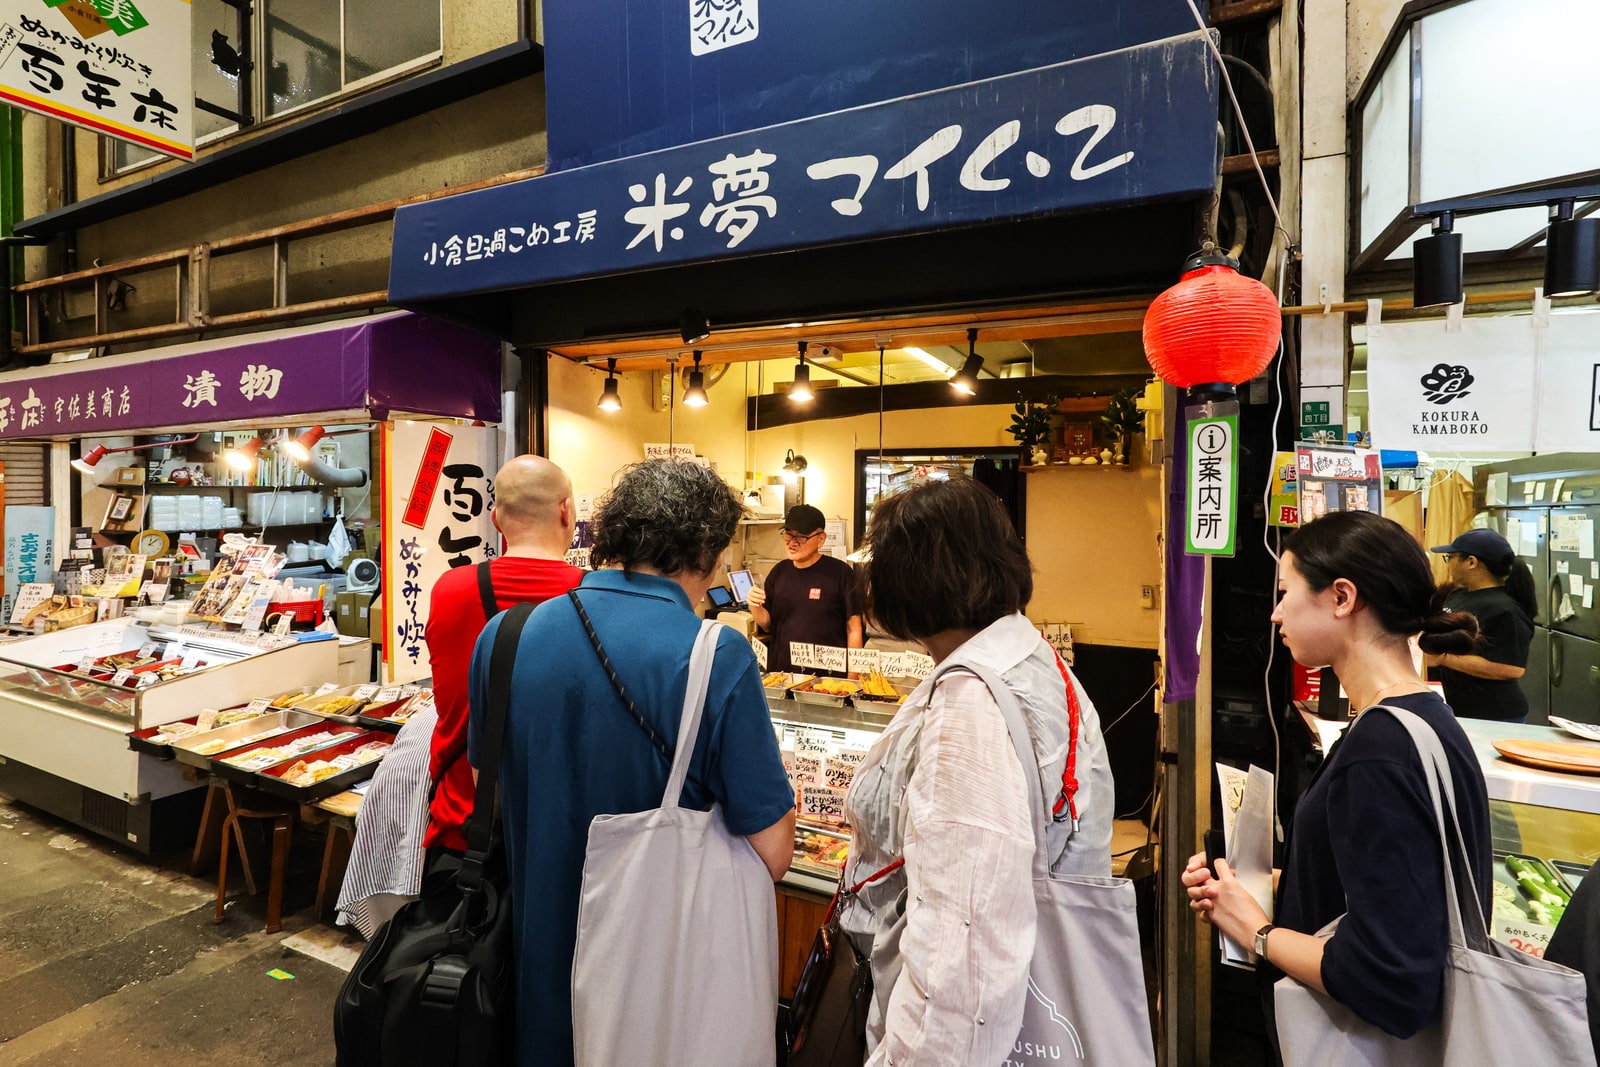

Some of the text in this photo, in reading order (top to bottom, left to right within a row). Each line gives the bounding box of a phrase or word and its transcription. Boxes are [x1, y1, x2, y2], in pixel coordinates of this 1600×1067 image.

[693, 9, 755, 45] マイム
[17, 42, 179, 131] 百年床
[423, 209, 598, 267] 小倉旦過こめ工房
[624, 148, 777, 253] 米夢
[54, 385, 131, 423] 宇佐美商店
[182, 364, 283, 408] 漬物
[1412, 423, 1489, 435] KAMABOKO
[1421, 410, 1480, 422] KOKURA
[1196, 456, 1223, 539] 案内所
[397, 536, 425, 664] ぬかみそ炊き
